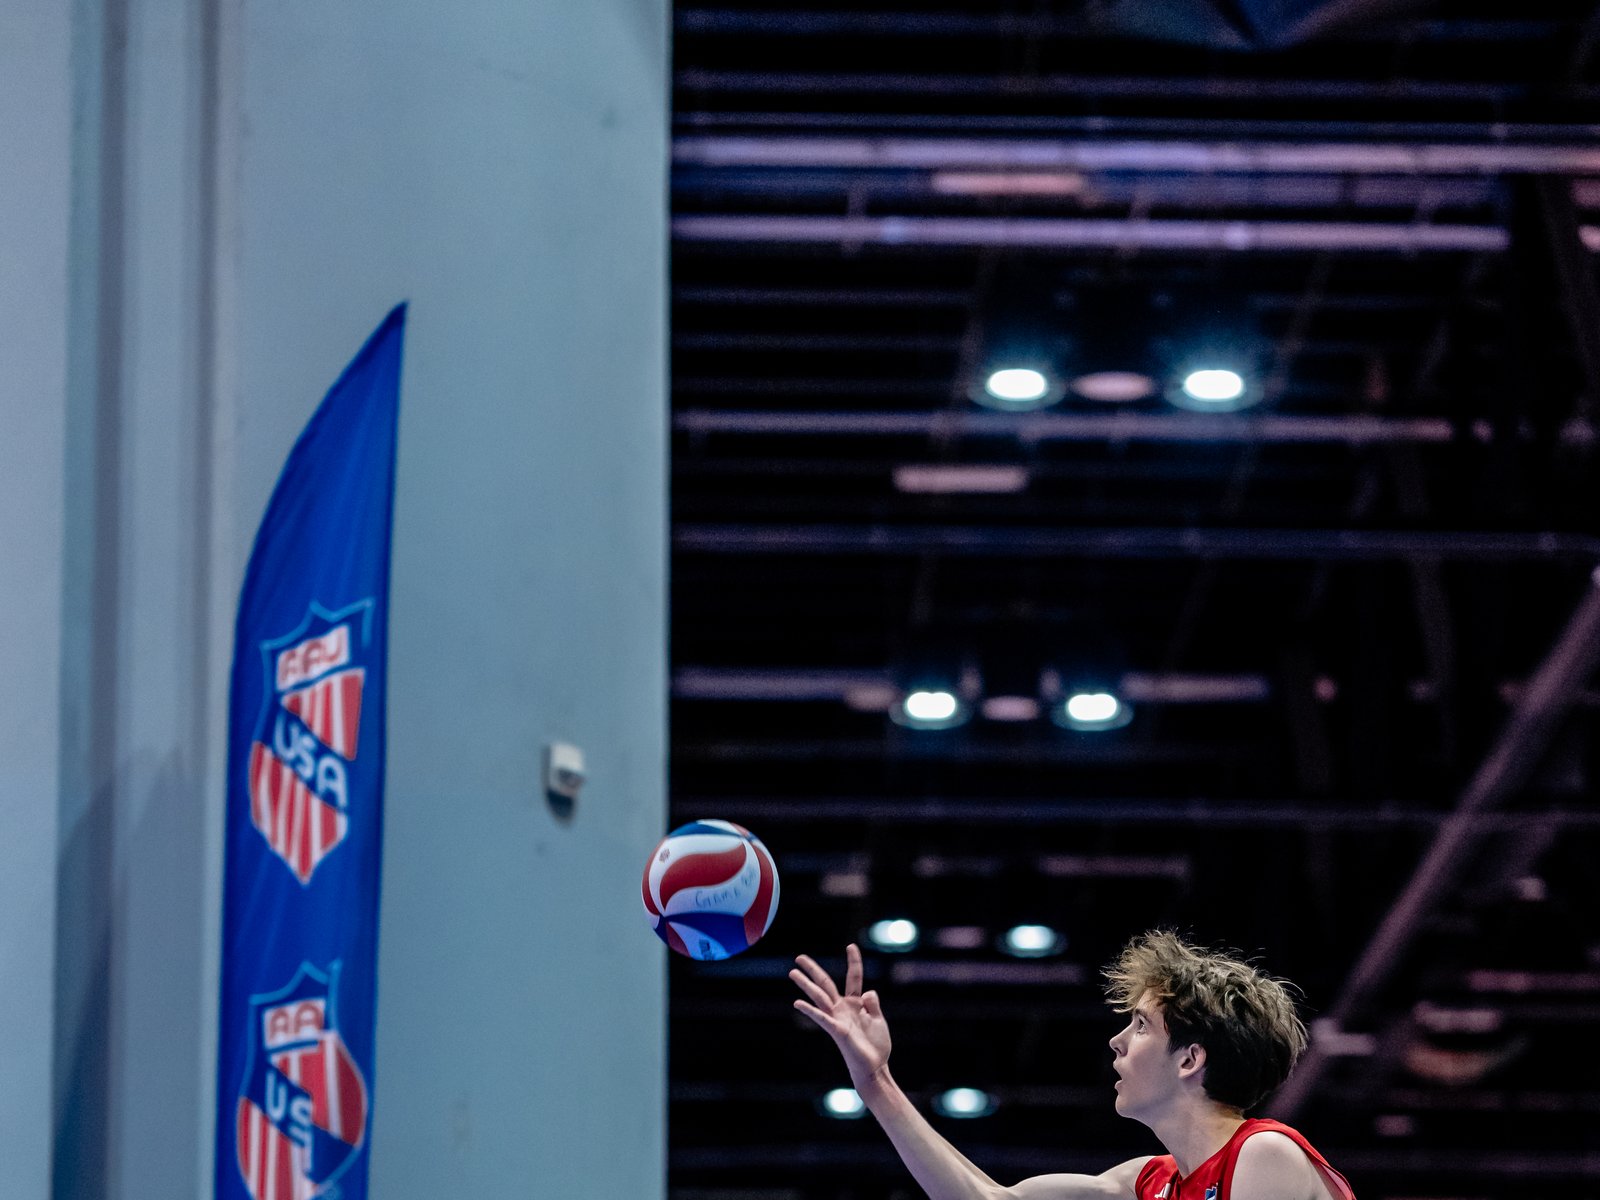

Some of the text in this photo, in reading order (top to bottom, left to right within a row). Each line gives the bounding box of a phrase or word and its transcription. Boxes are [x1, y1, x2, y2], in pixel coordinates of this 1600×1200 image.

[278, 630, 344, 684] AAU
[273, 712, 348, 808] USA
[268, 1001, 324, 1041] AA
